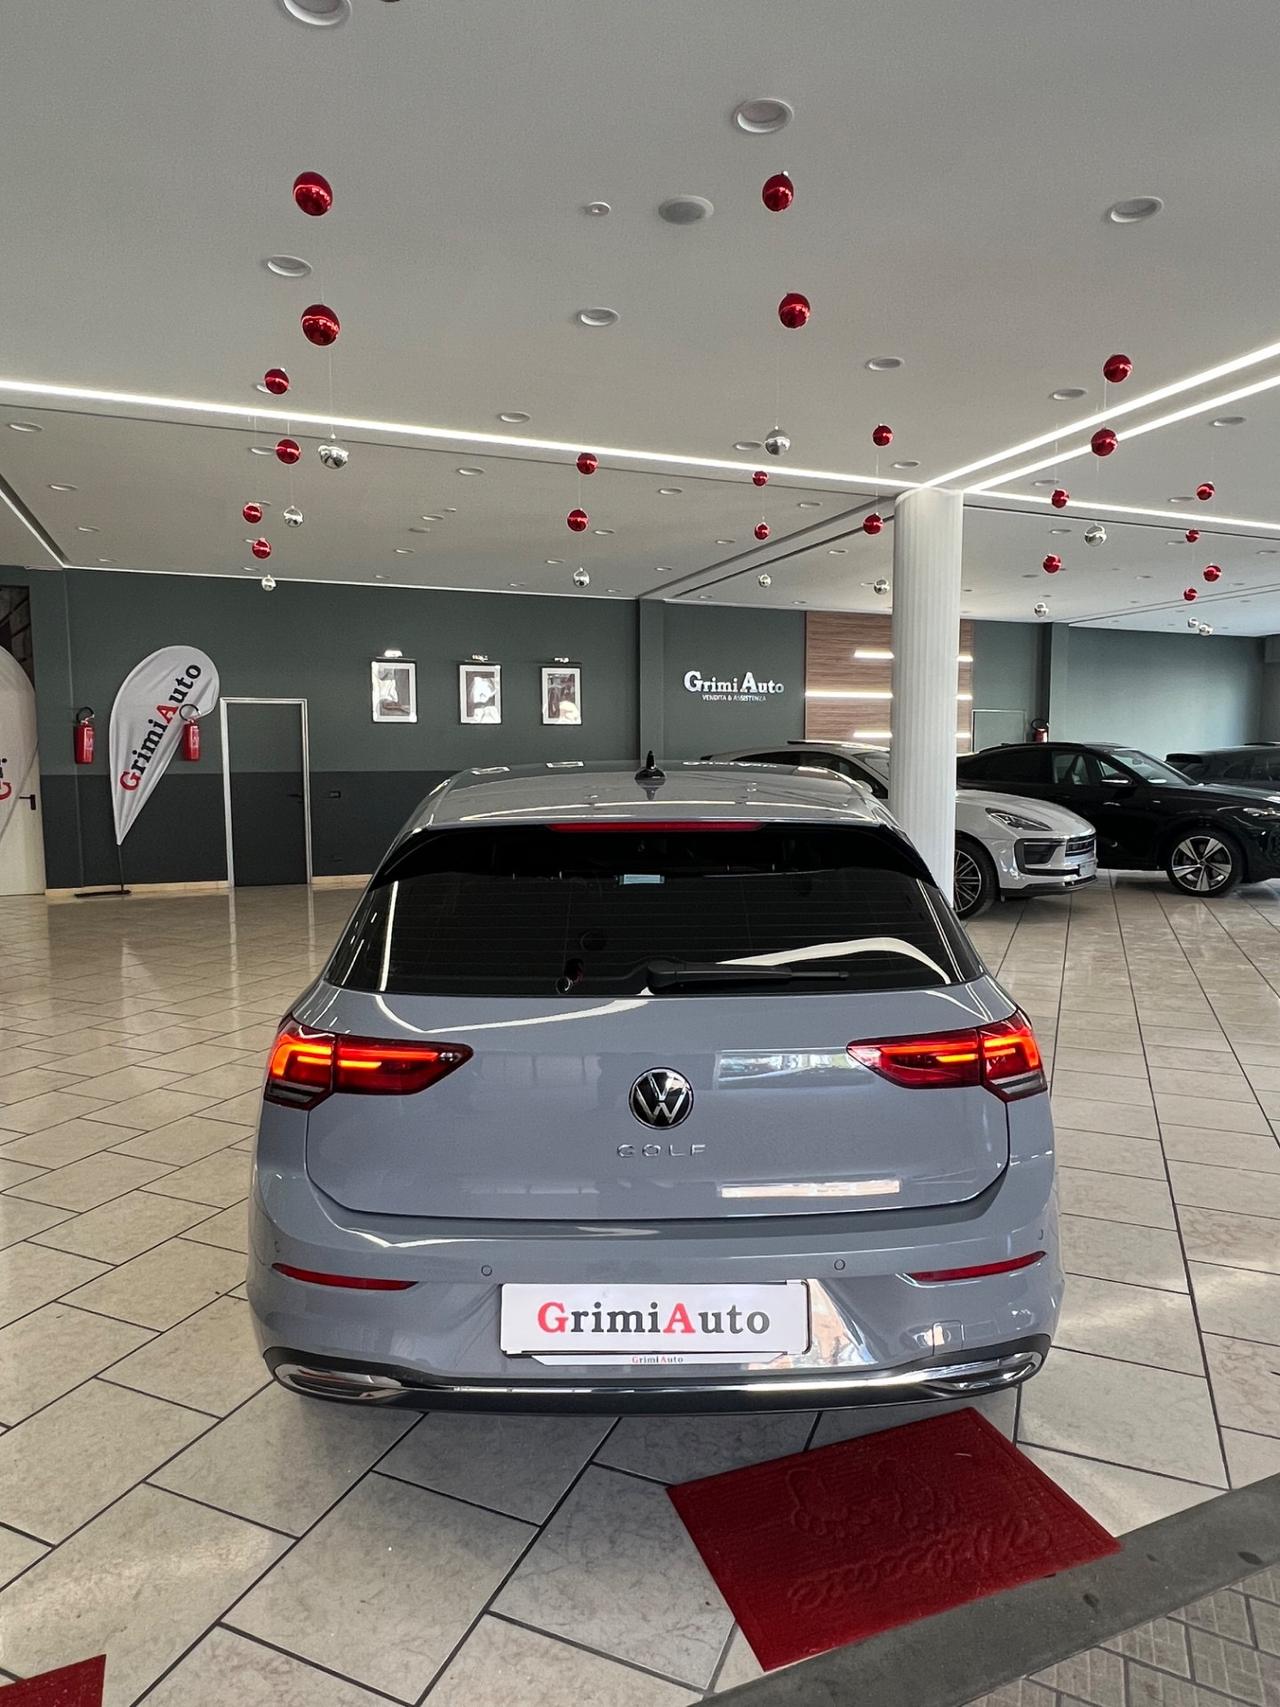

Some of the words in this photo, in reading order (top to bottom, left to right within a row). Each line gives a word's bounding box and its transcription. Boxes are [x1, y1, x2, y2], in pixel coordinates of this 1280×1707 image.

[733, 694, 766, 702] ASSISTENZA
[119, 664, 202, 791] GrimiAuto
[617, 1144, 706, 1157] GOLF
[537, 1301, 770, 1334] GrimiAuto
[631, 1355, 684, 1364] GrimiAuto
